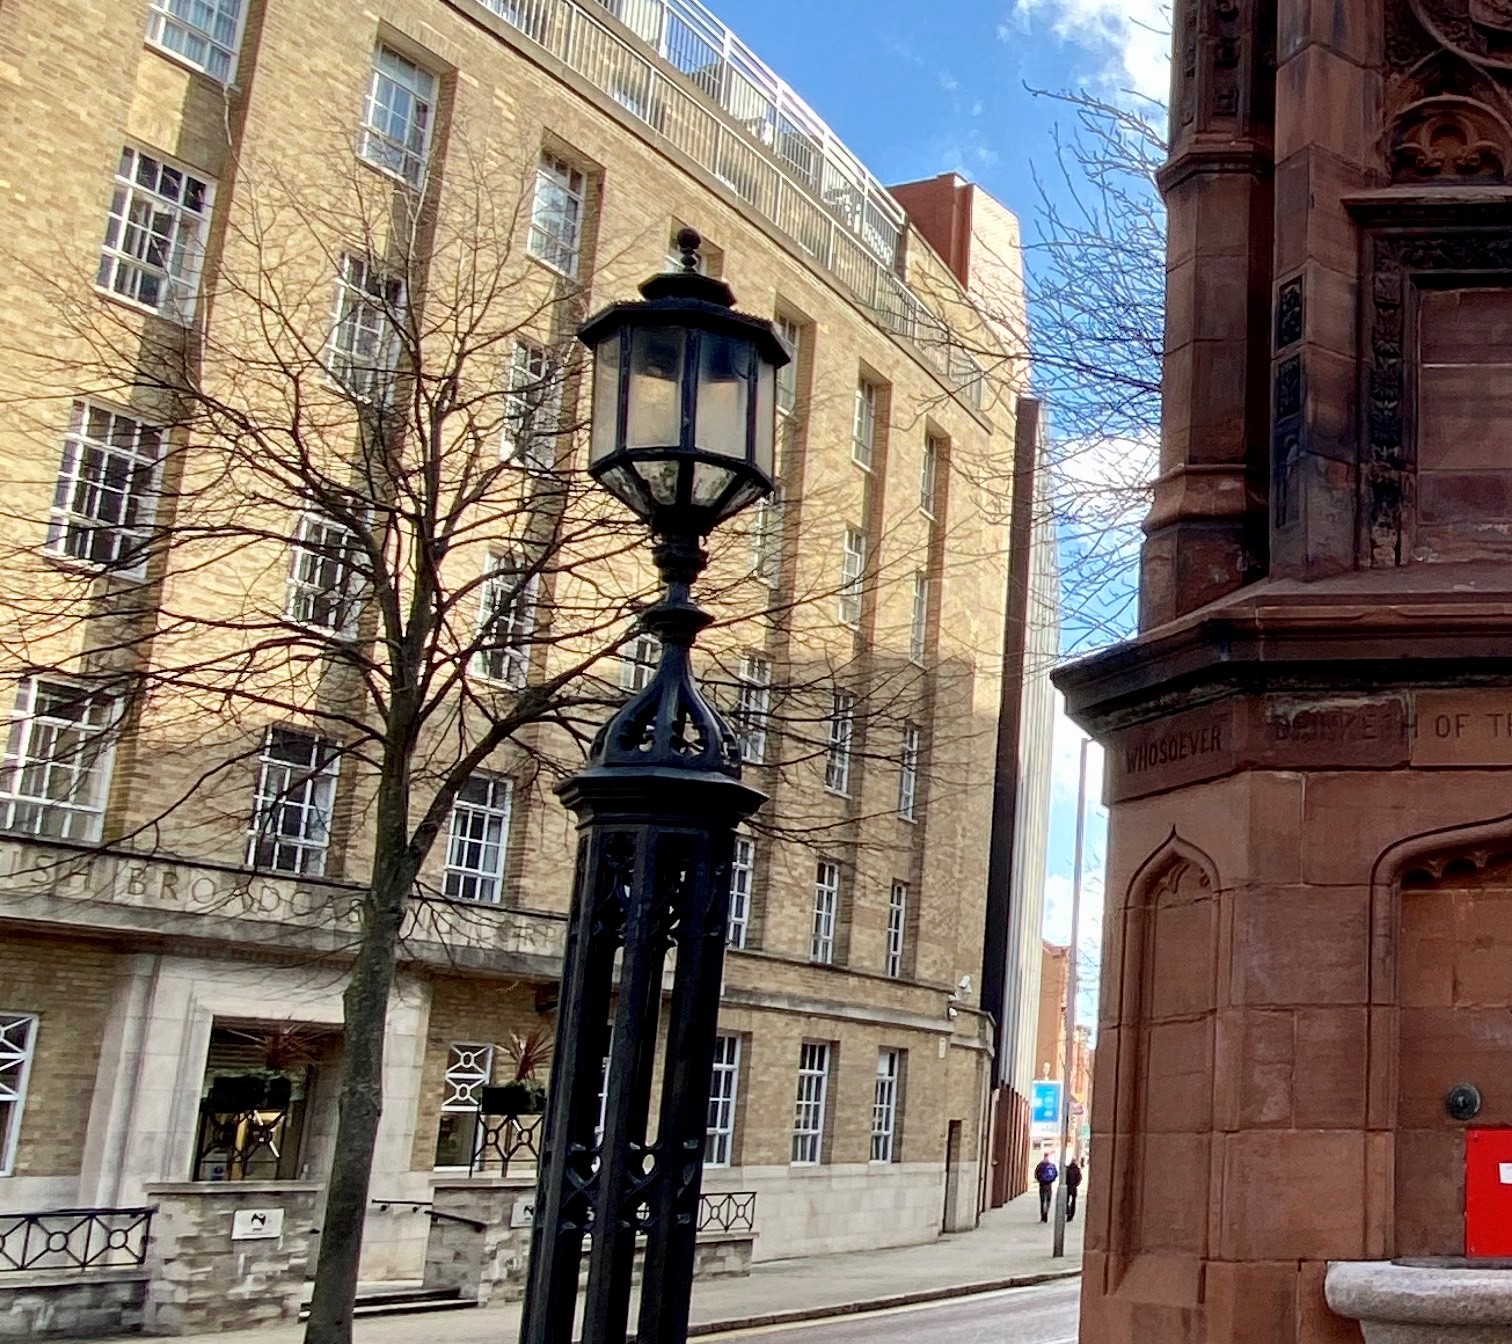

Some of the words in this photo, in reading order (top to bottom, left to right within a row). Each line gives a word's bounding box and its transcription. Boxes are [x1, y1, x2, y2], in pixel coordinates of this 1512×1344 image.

[1126, 725, 1222, 774] WHOSOEVER
[1435, 713, 1470, 738] OF
[0, 849, 92, 891] ISH
